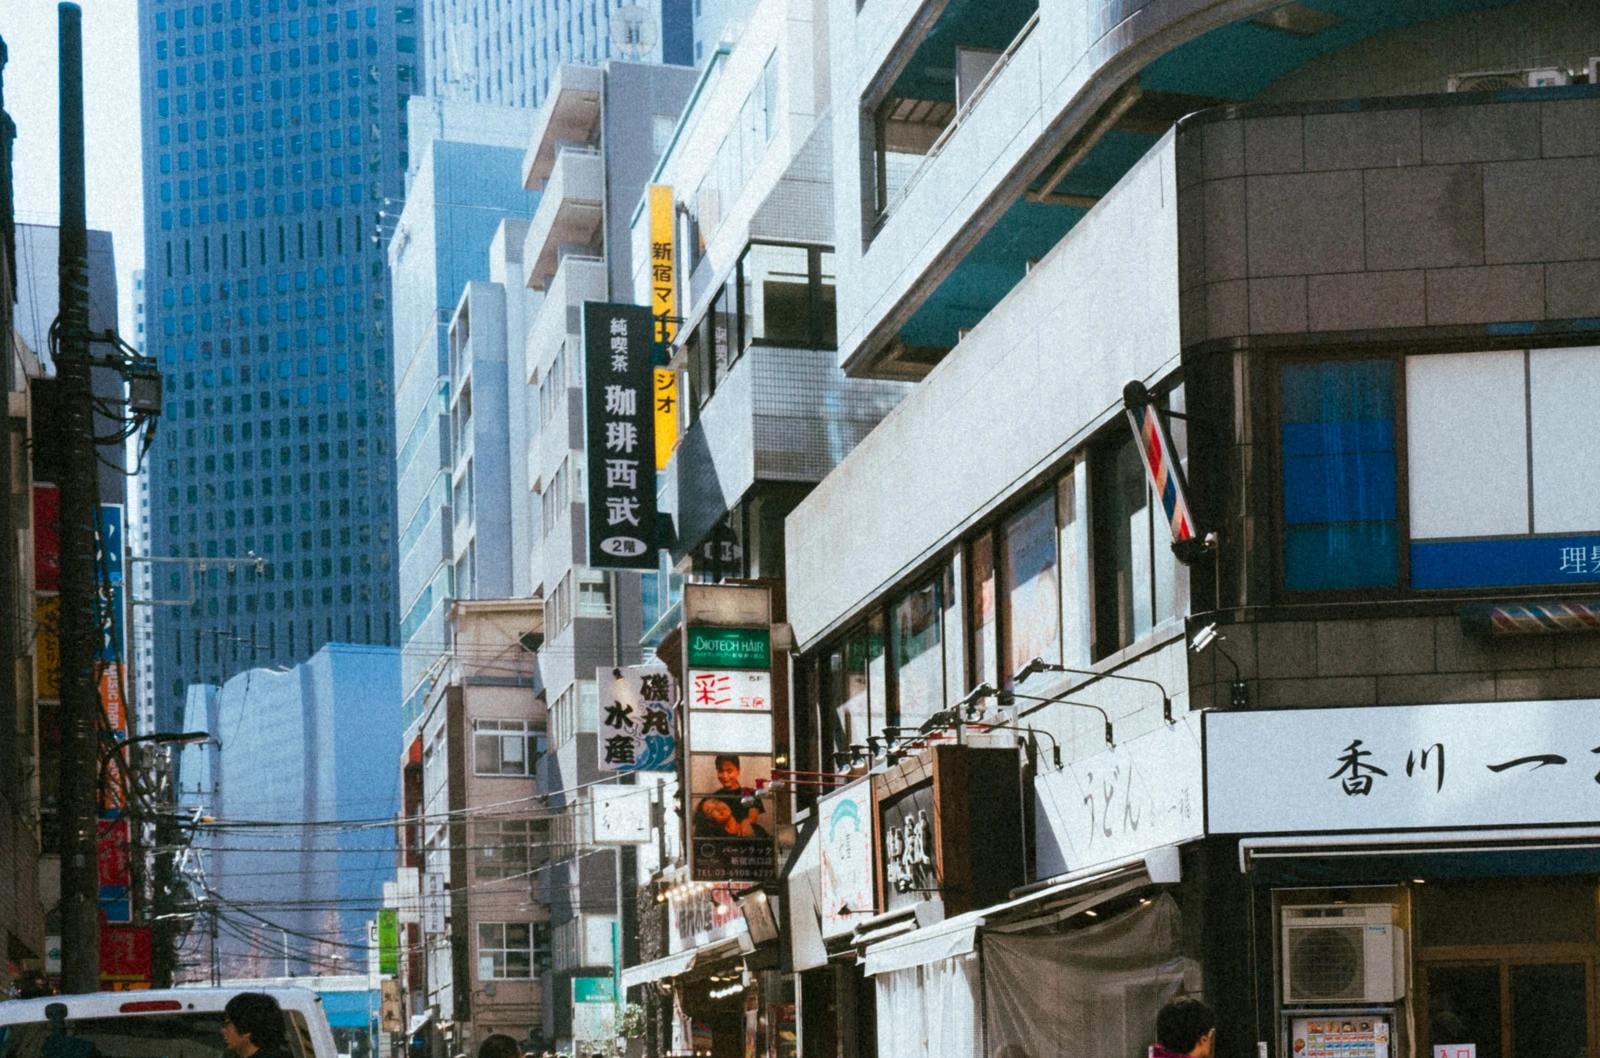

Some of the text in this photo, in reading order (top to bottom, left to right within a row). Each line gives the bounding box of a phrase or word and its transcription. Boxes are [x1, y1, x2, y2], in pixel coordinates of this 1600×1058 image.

[610, 318, 628, 372] 純喫茶
[604, 384, 640, 527] 珈琲西武
[611, 540, 637, 554] 2階
[741, 639, 764, 652] HAIR
[640, 673, 670, 737] 磯丸
[695, 674, 732, 705] 彩
[604, 701, 635, 767] 水産
[1083, 762, 1141, 847] うどん
